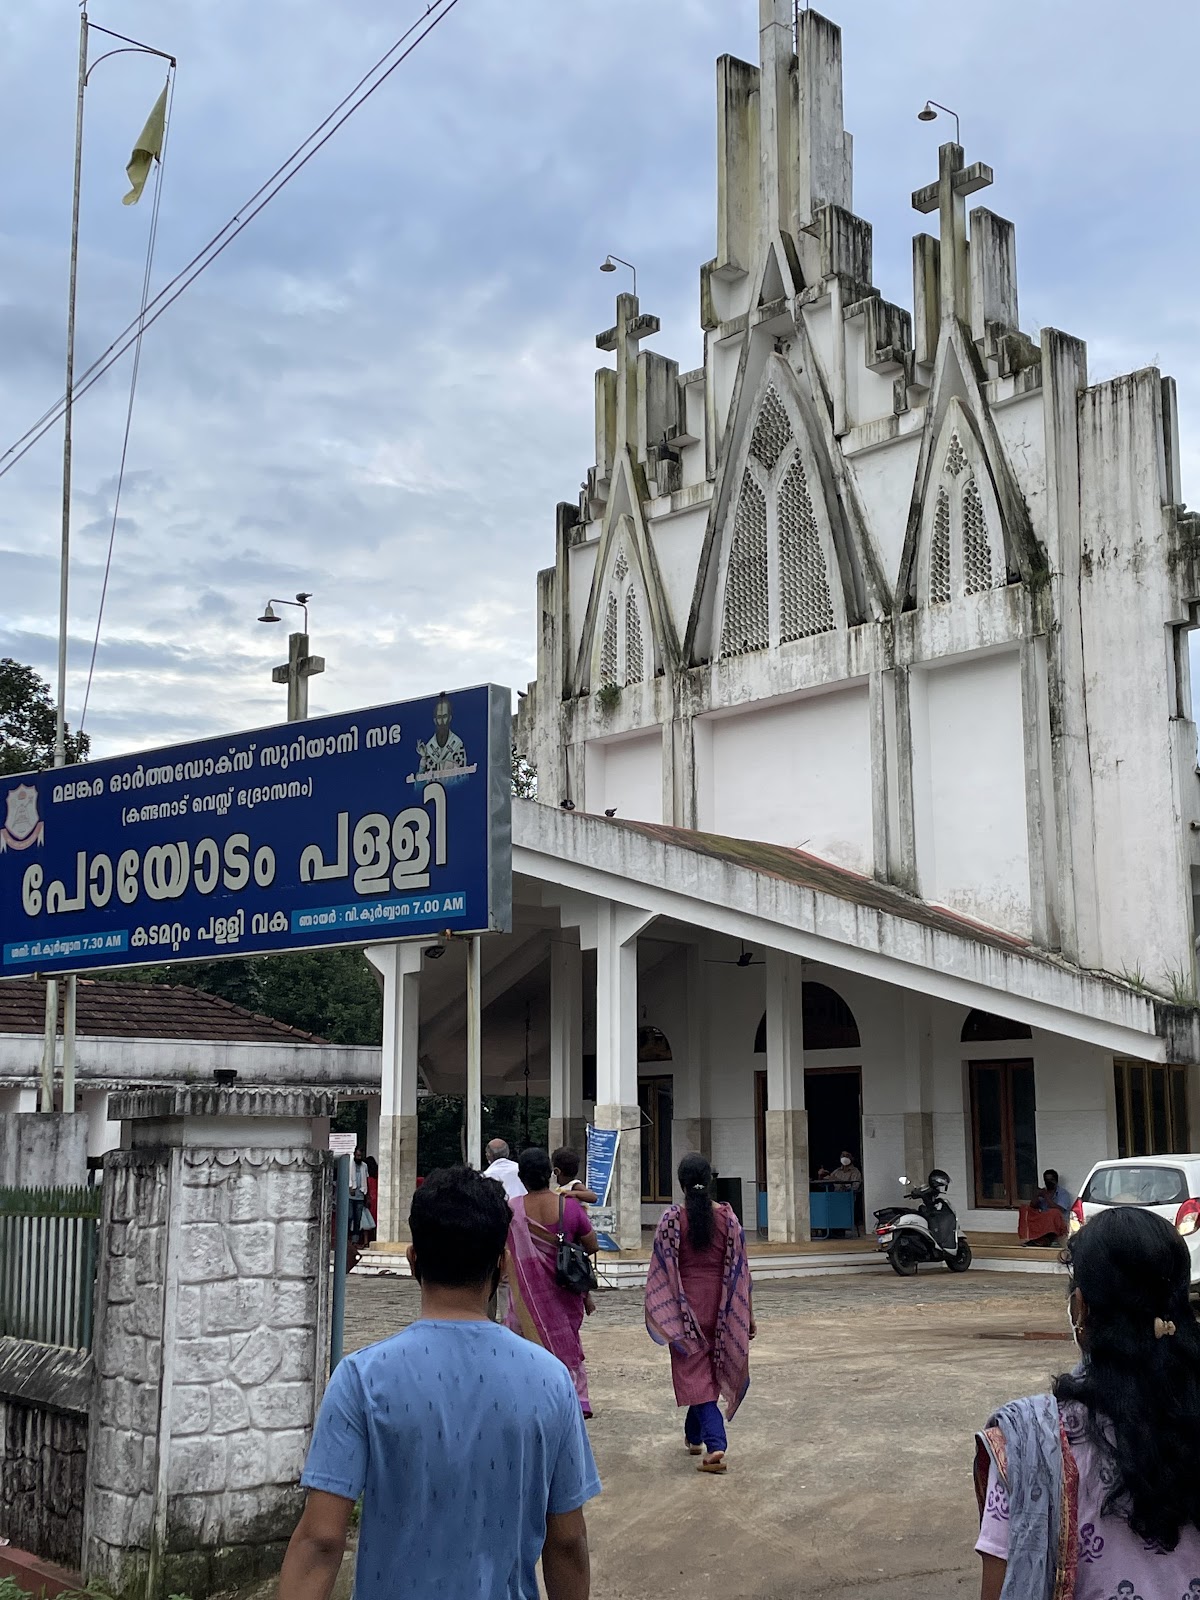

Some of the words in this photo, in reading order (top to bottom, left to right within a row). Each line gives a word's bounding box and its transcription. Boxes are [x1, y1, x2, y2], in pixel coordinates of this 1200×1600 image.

[53, 778, 104, 803] മലങ്കര
[109, 744, 257, 793] ഓർത്തഡോക്സ്
[260, 725, 359, 769] സുറിയാനി
[366, 724, 401, 749] സഭ
[192, 787, 235, 815] വെസ്റ്റ്
[237, 776, 313, 808] ഭദ്രാസനം)
[300, 782, 447, 895] പള്ളി
[412, 899, 440, 914] 7.00
[442, 896, 464, 911] AM
[82, 937, 103, 950] 7.30
[105, 934, 122, 948] AM
[131, 922, 191, 951] കടമറ്റം
[198, 908, 245, 944] പള്ളി
[252, 911, 288, 935] വക
